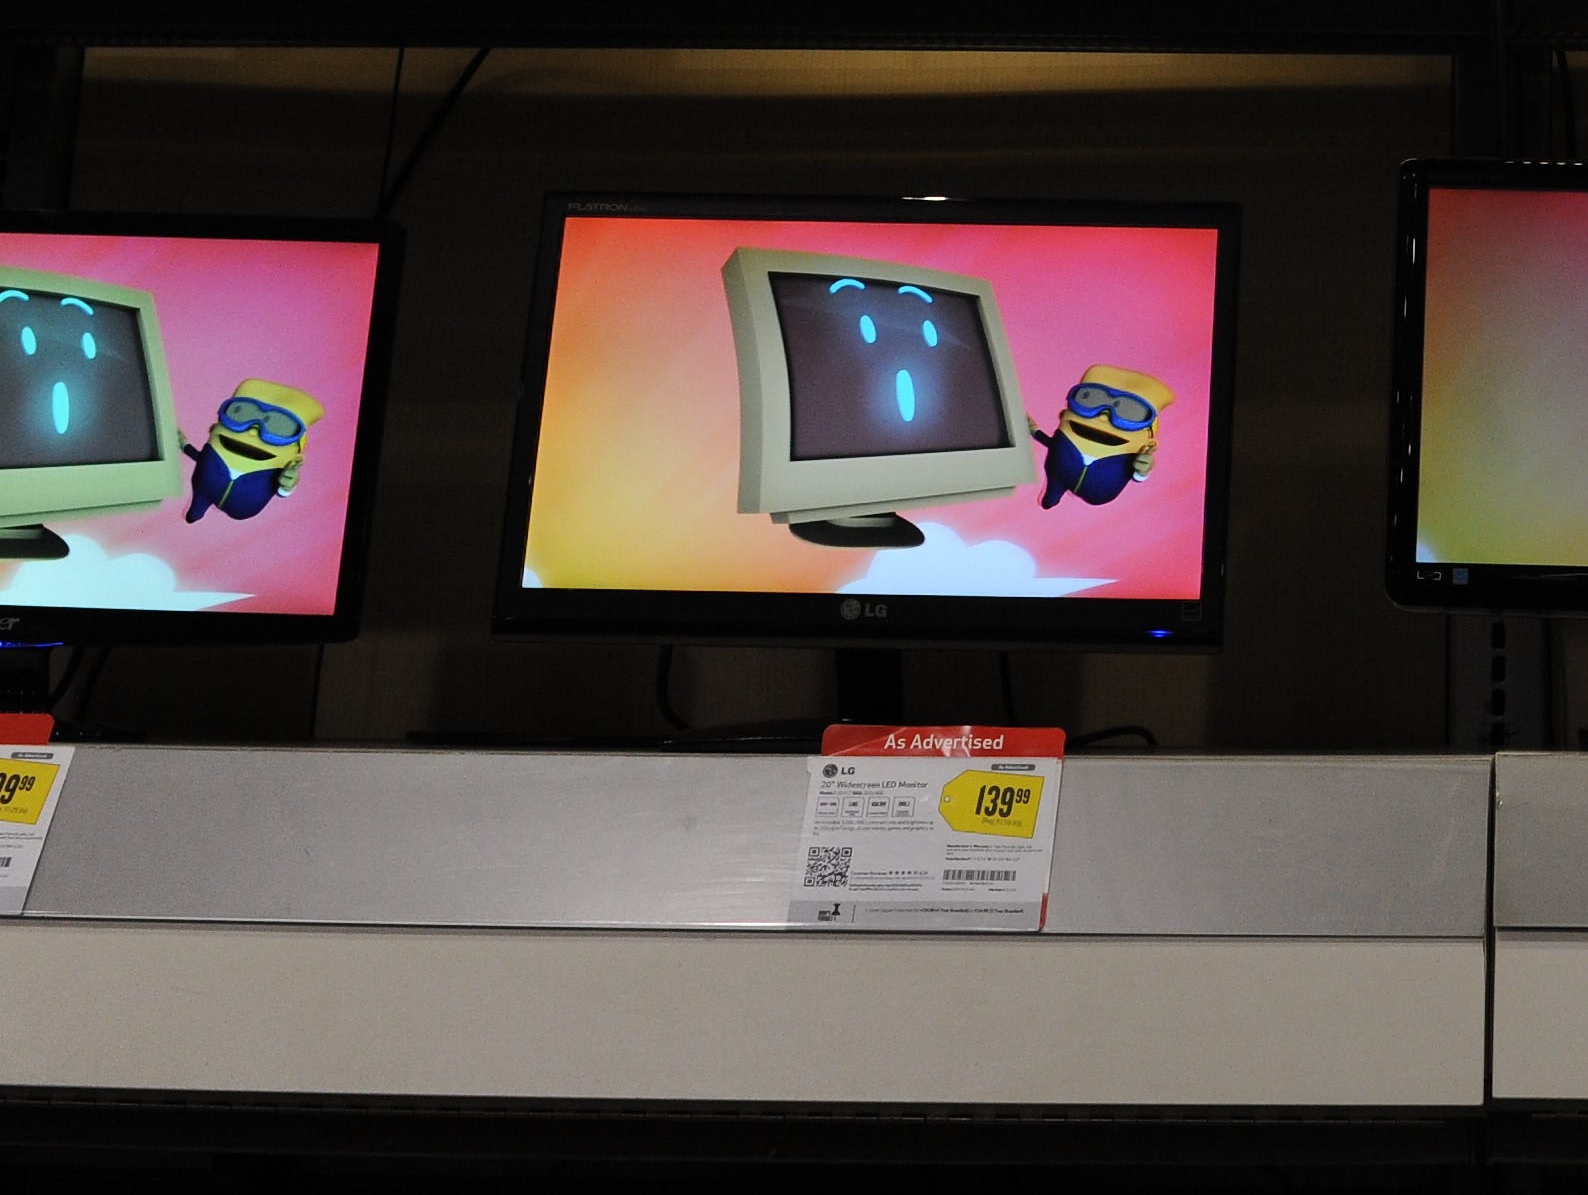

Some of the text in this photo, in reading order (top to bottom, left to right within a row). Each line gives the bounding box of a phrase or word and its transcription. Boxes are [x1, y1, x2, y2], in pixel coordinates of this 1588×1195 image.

[865, 604, 887, 618] LG
[883, 733, 1004, 750] As Advertised
[841, 766, 856, 775] LG
[837, 781, 881, 789] Widescreen
[882, 780, 897, 789] LED
[898, 781, 928, 789] Monitor
